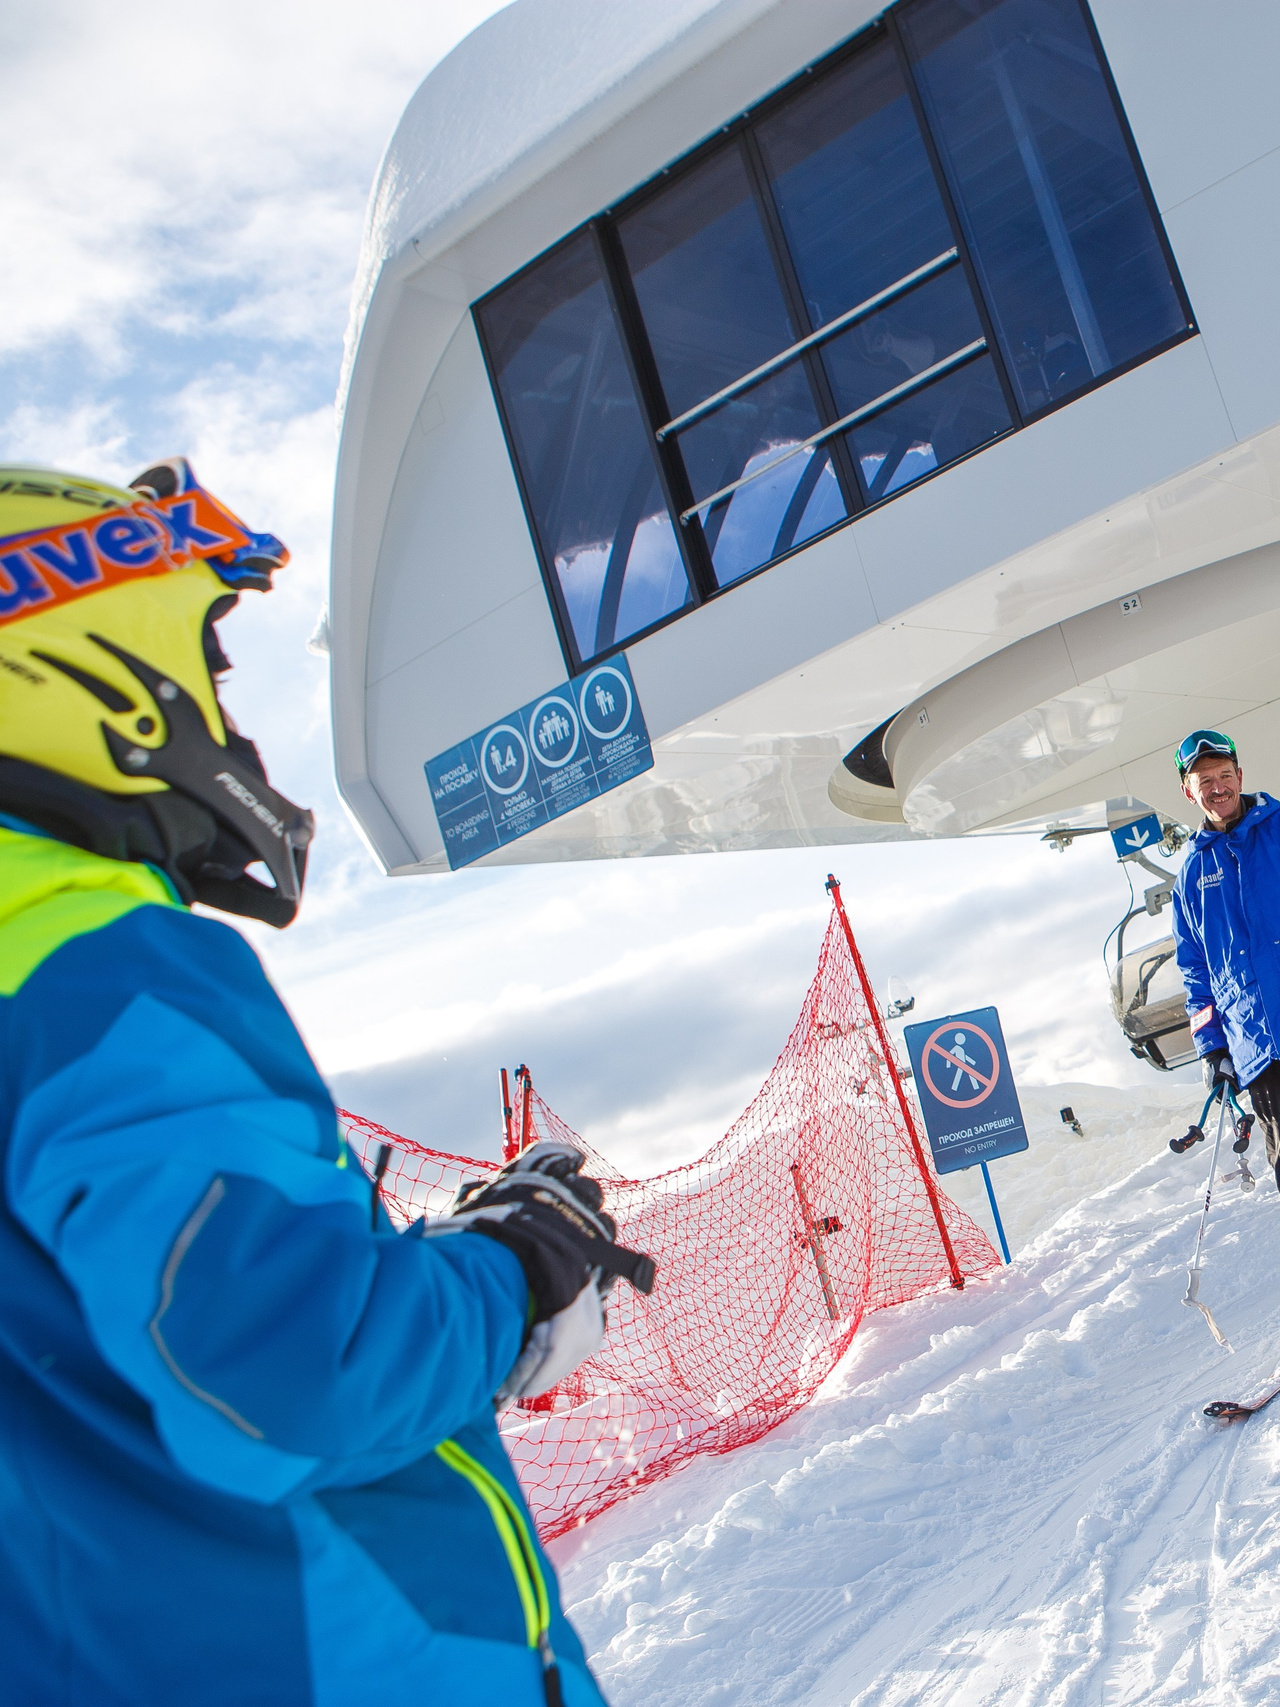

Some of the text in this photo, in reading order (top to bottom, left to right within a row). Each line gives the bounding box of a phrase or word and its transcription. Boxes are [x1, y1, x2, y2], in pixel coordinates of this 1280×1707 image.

[434, 768, 478, 800] НА ПОСАДКУ
[440, 763, 468, 785] ПРОХОД
[504, 790, 528, 808] ТОЛЬКО
[504, 796, 536, 817] ЧЕЛОВЕКА
[445, 810, 489, 838] TO BOARDING
[511, 809, 536, 828] PERSONS
[516, 822, 531, 834] ONLY
[462, 827, 479, 842] AREA
[938, 1116, 1014, 1144] ПРОХОД ЗАПРЕЩЕН
[964, 1140, 997, 1154] NO ENTRY
